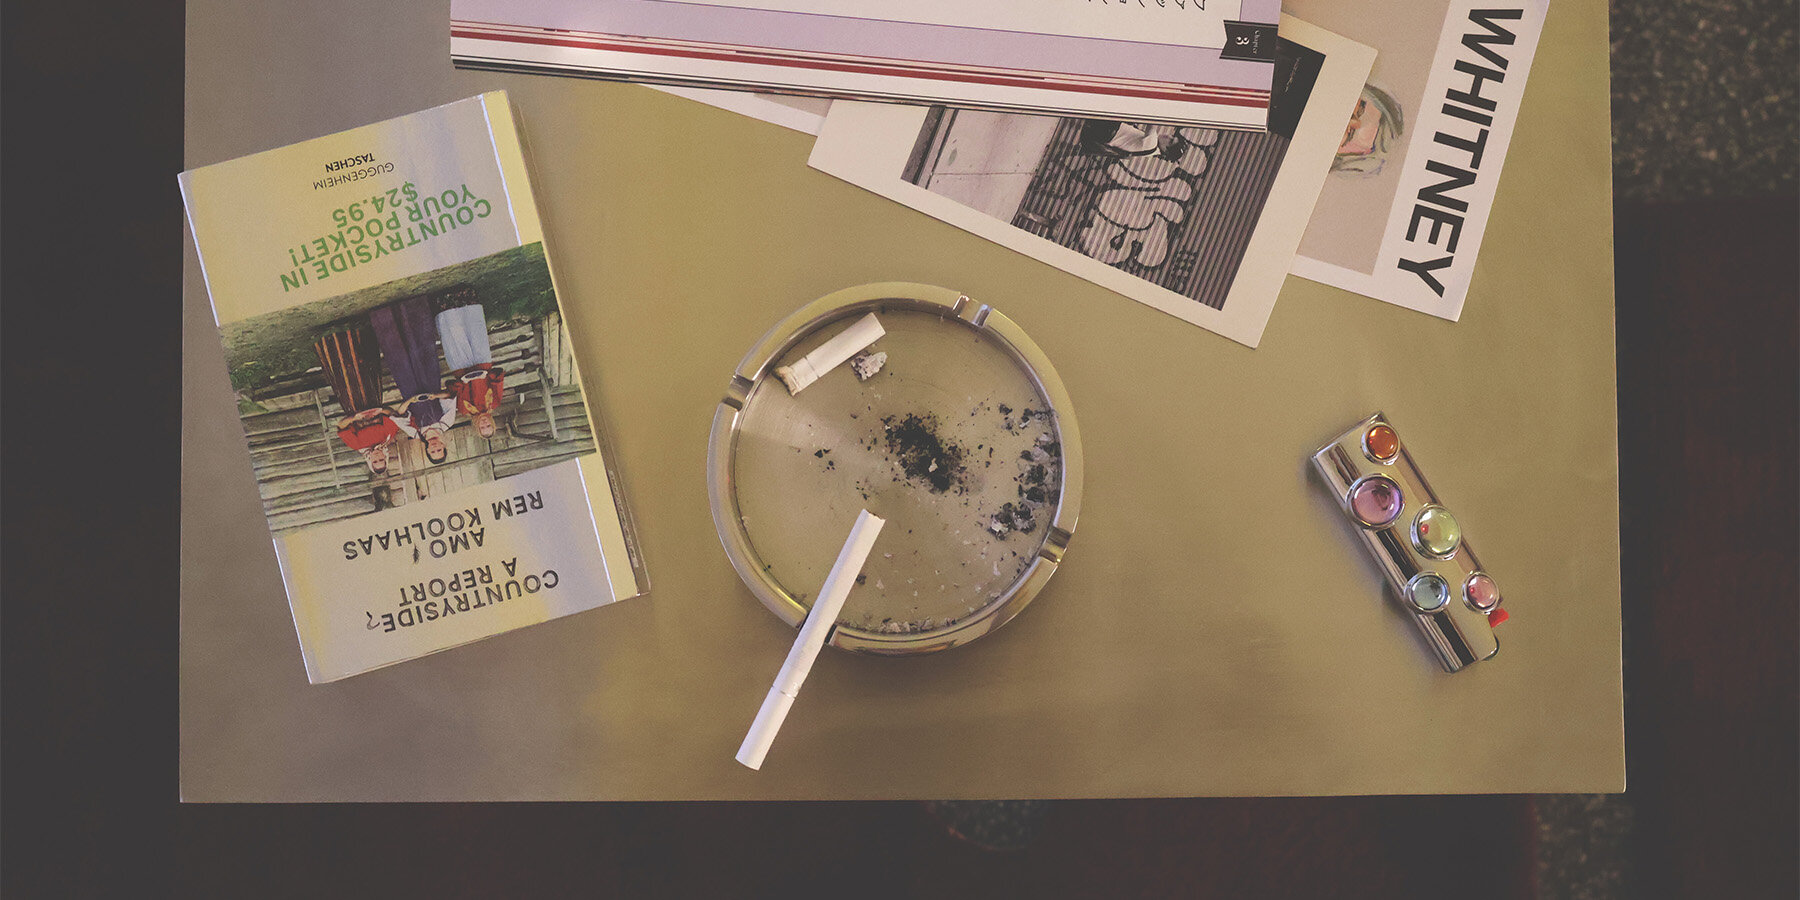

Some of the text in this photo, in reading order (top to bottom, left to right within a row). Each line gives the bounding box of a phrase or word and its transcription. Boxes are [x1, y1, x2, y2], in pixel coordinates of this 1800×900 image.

[1236, 36, 1250, 45] 3
[313, 162, 395, 190] GUGGENHEIM
[325, 153, 376, 173] TASCHEN
[1397, 9, 1524, 298] WHITNEY
[288, 184, 477, 267] YOUR POCKET!
[332, 181, 419, 229] $24.95
[280, 198, 492, 292] COUNTRYSIDE IN
[342, 490, 545, 560] REM KOOLHAAS
[429, 527, 485, 558] AMO
[398, 557, 518, 607] A REPORT
